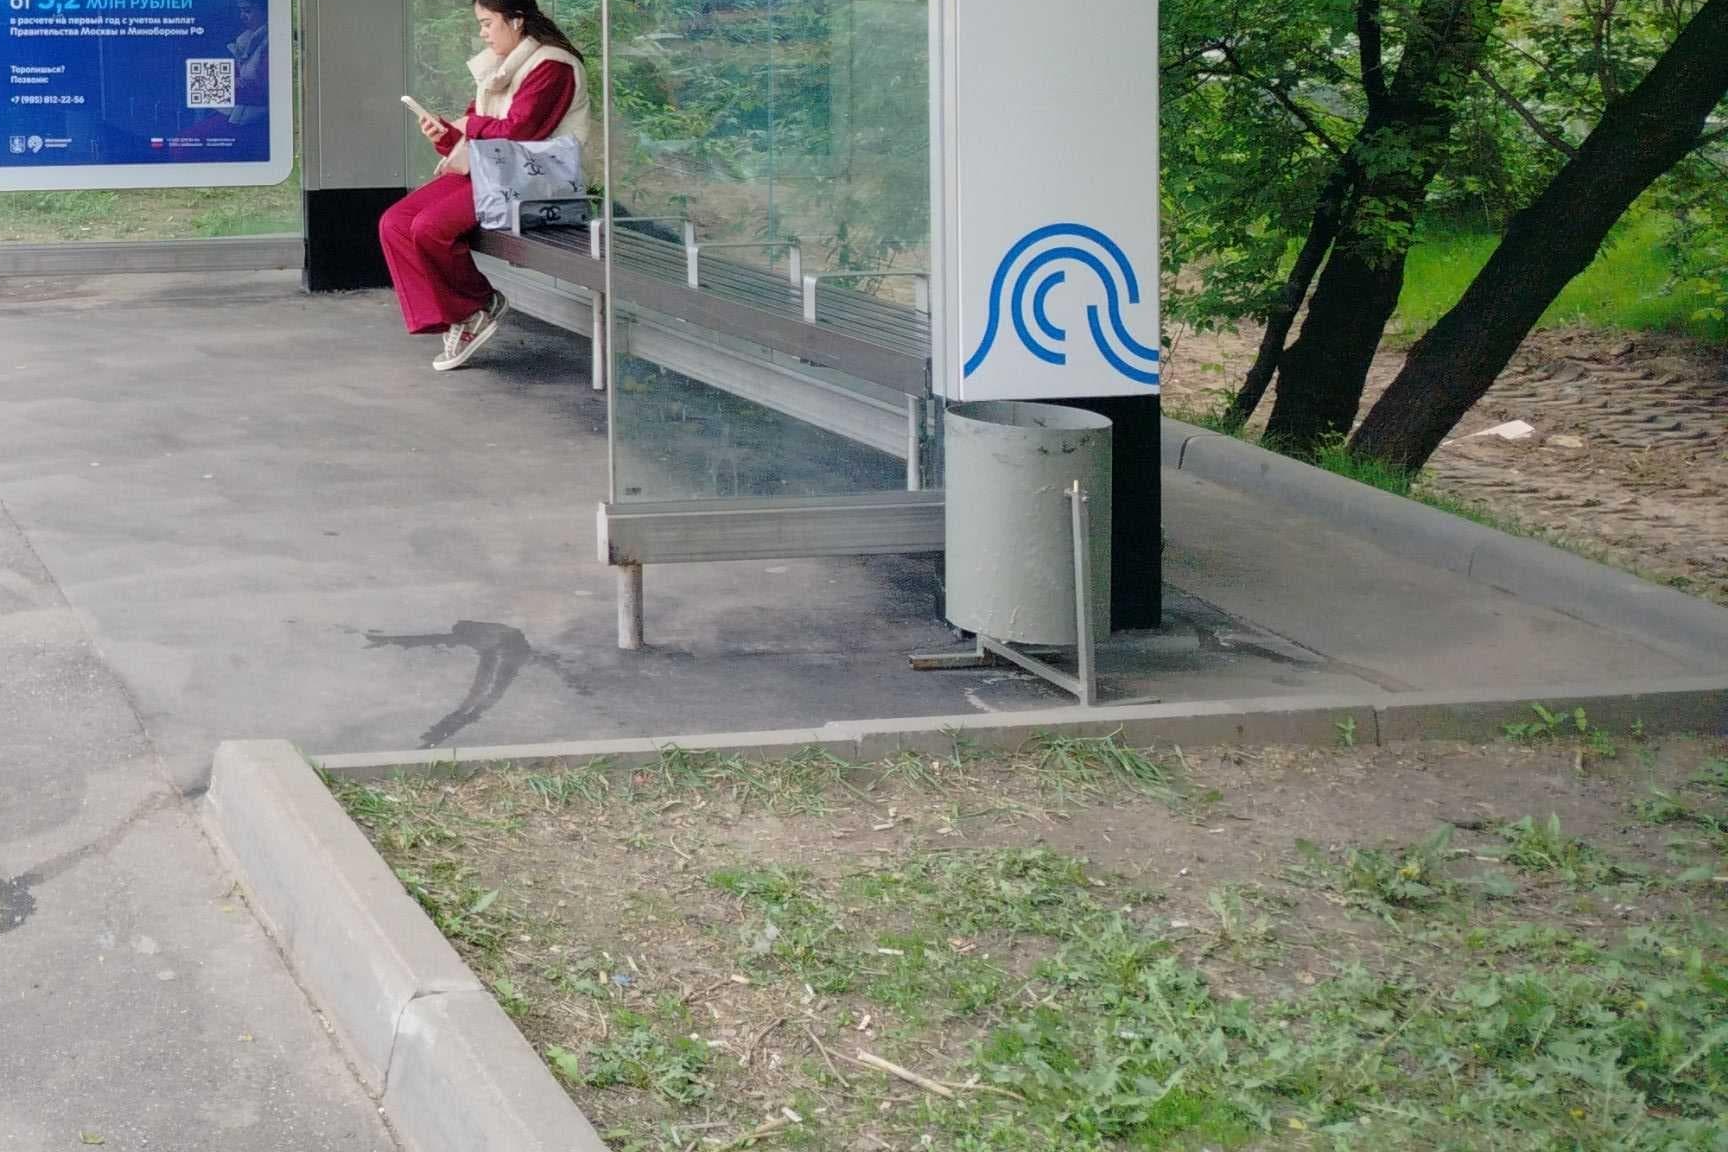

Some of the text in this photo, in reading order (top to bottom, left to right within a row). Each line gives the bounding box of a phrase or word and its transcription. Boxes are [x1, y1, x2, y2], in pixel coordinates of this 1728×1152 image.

[68, 16, 104, 26] первый
[105, 17, 121, 26] год
[128, 17, 161, 26] учетом
[162, 17, 196, 25] выплат
[10, 27, 79, 37] Правительства
[81, 27, 118, 36] Москвы
[128, 27, 189, 36] Минобороны
[190, 26, 205, 36] РФ
